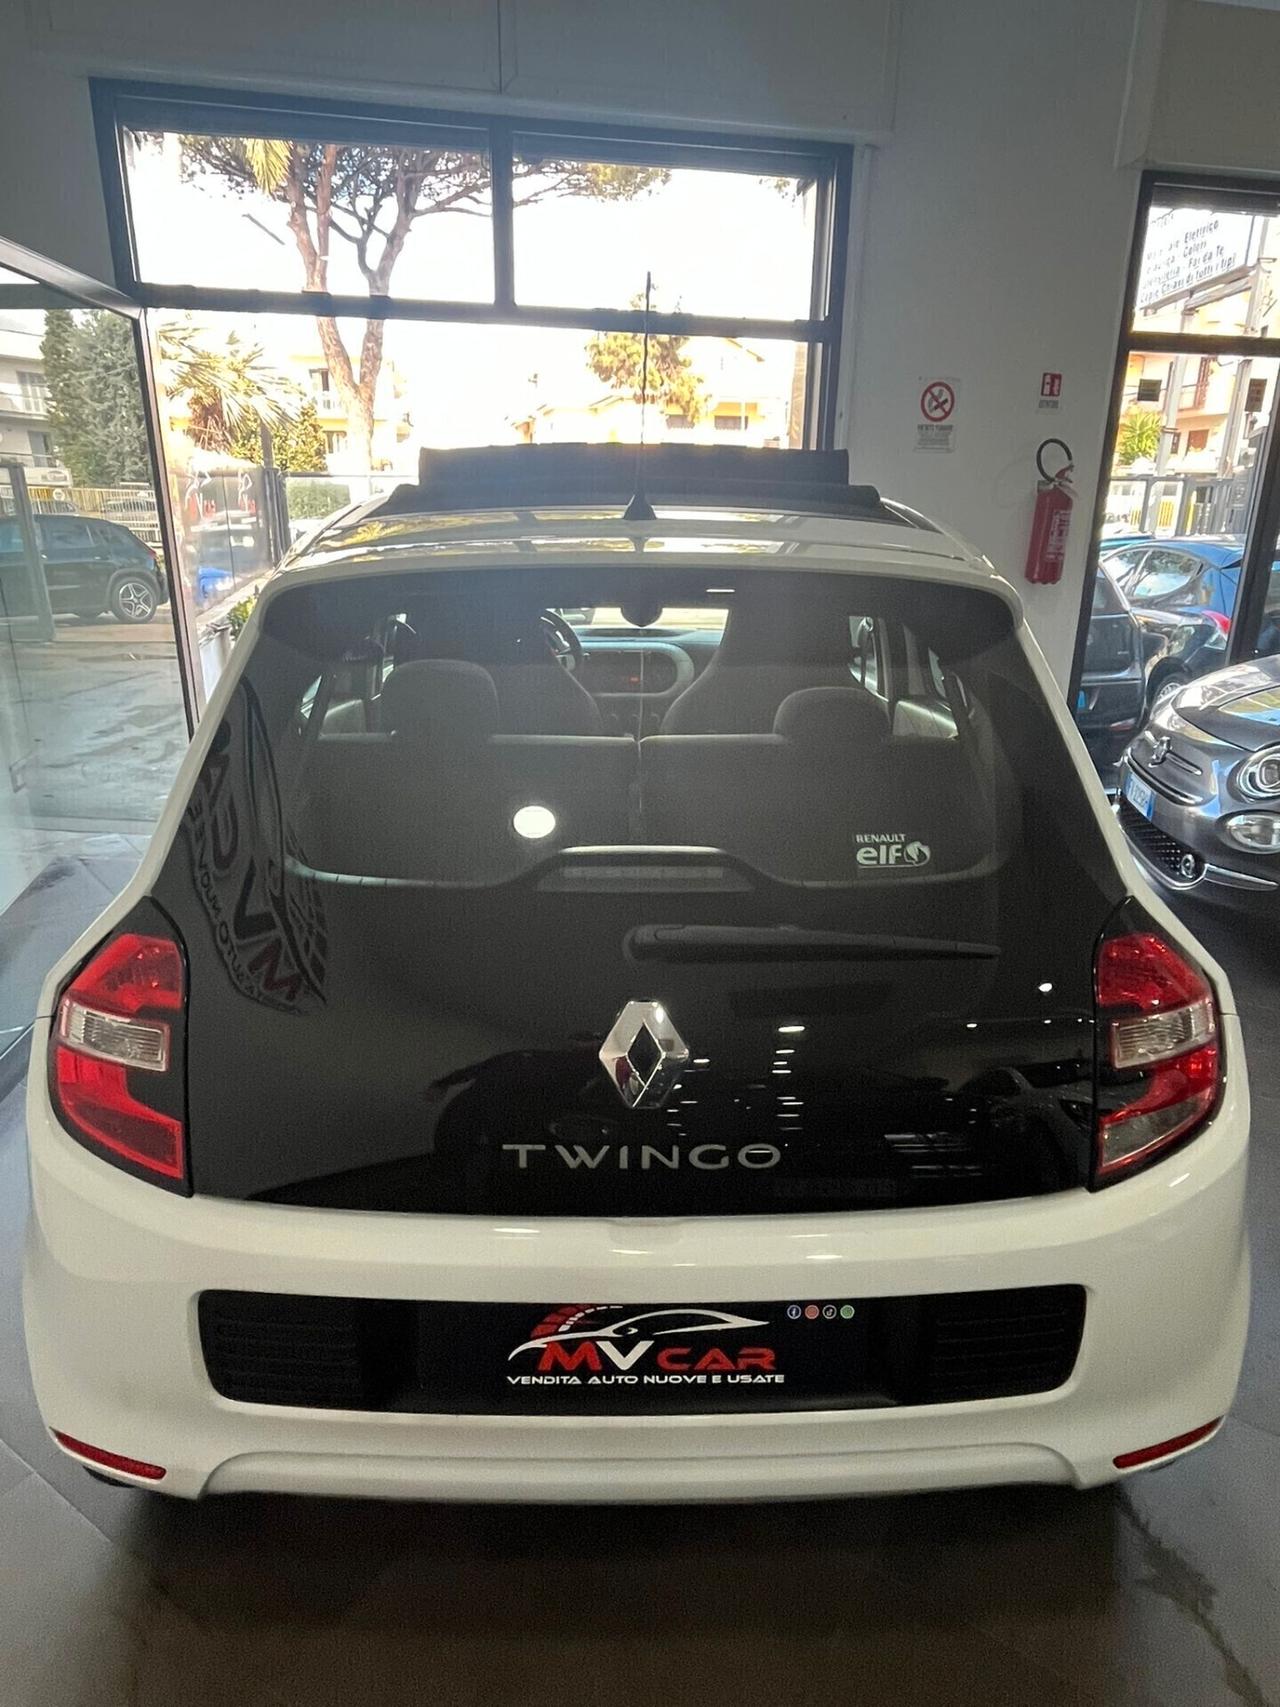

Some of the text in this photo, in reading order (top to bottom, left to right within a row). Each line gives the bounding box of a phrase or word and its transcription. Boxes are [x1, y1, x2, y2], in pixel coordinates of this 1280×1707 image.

[855, 833, 906, 843] RENAULT
[502, 1143, 782, 1169] TWINGO
[506, 1374, 785, 1385] VENDITA AUTO NUOVE E USATE
